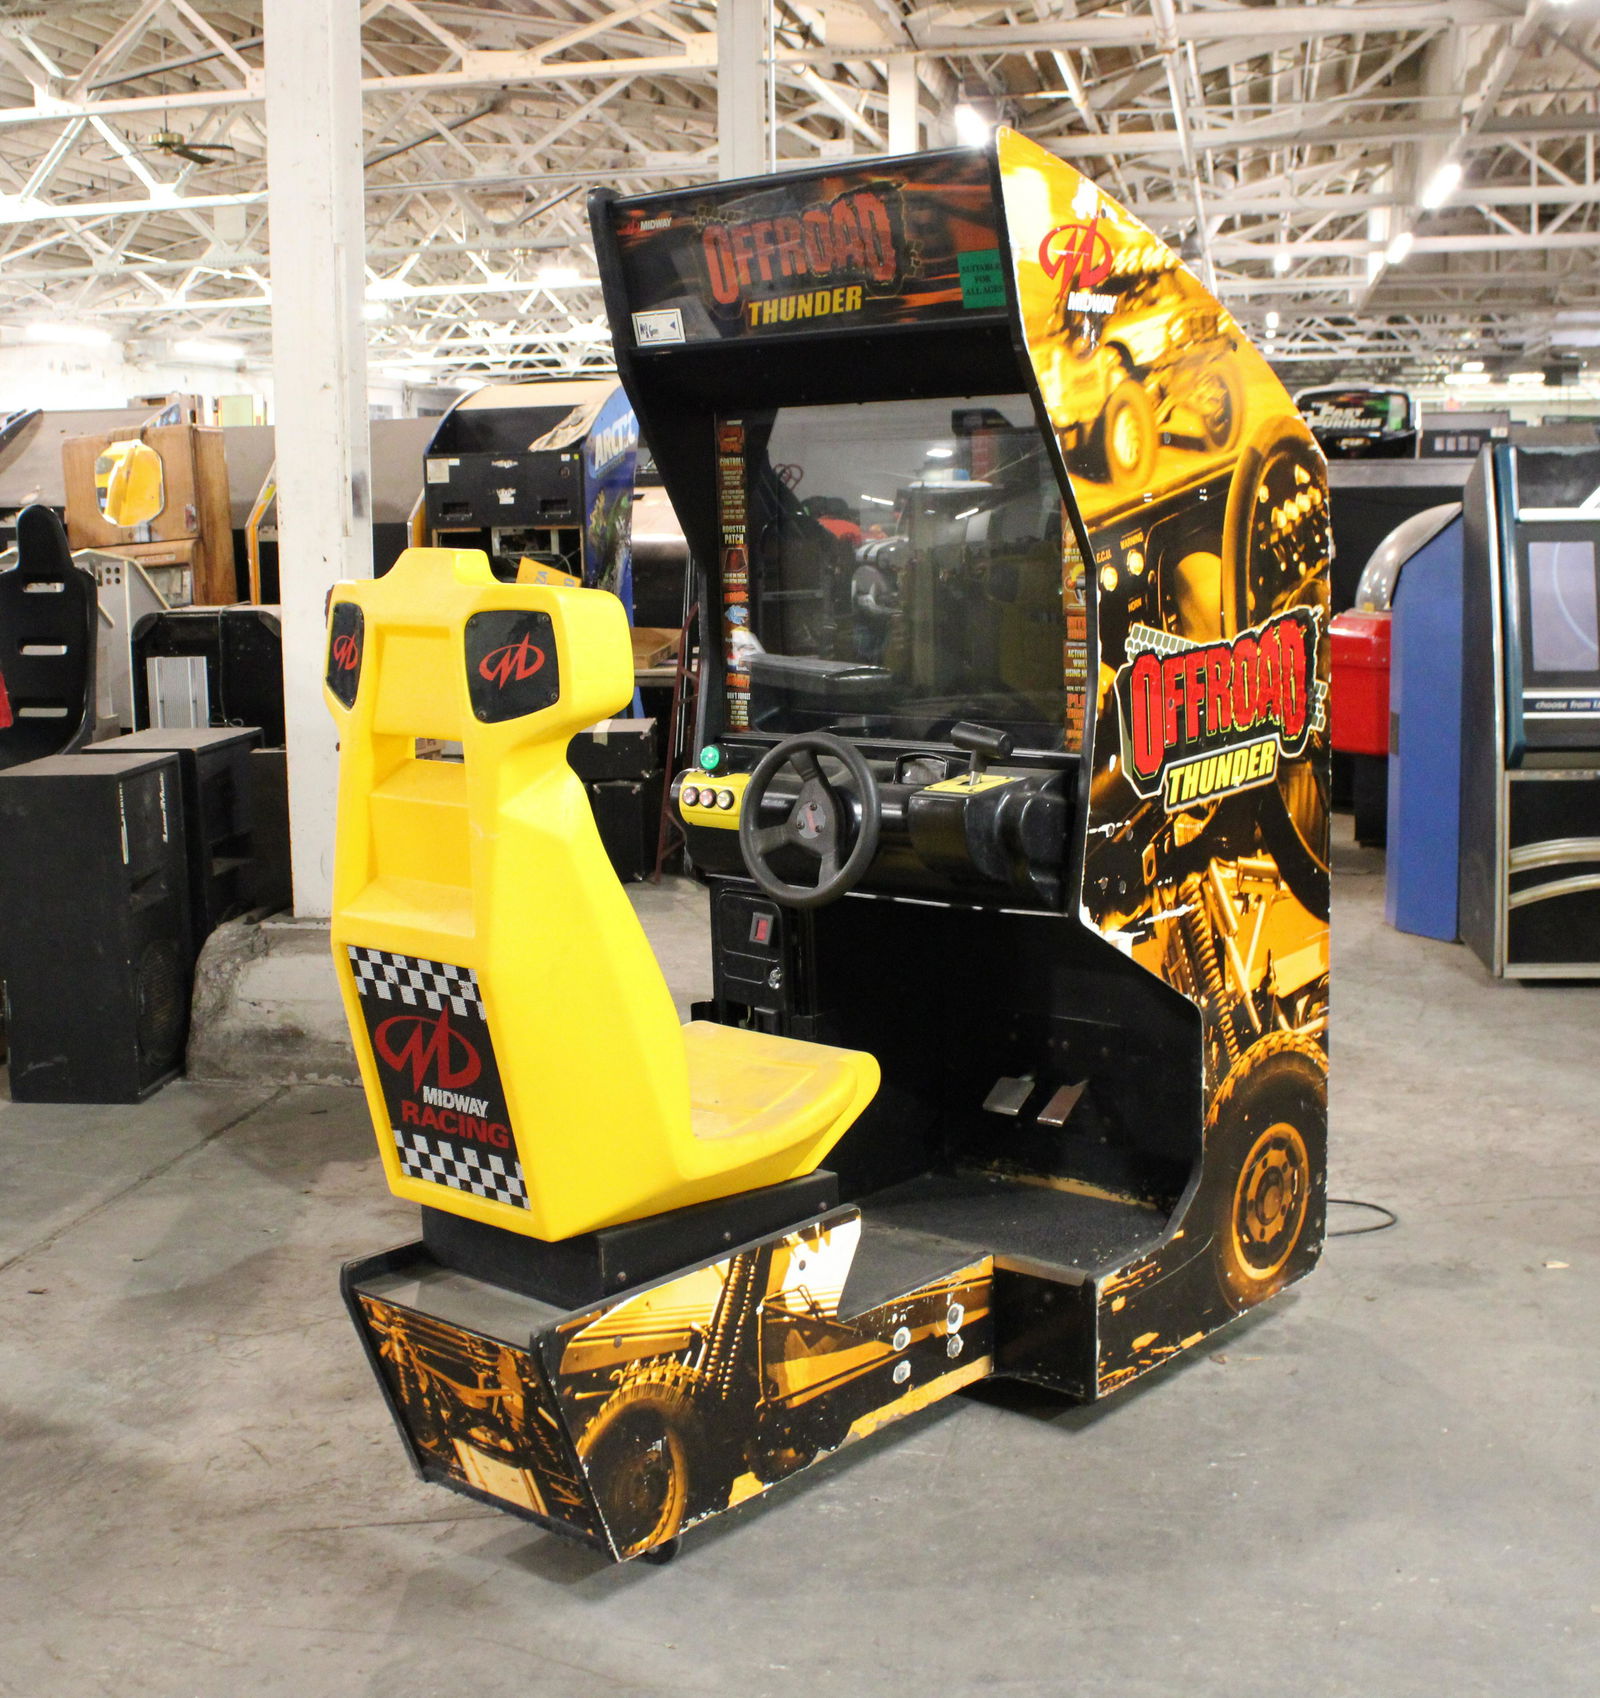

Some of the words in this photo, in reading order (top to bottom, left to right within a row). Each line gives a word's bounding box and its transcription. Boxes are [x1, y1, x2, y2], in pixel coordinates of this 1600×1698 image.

[640, 217, 672, 231] MIDWAY
[702, 193, 898, 305] OFFROAD
[748, 285, 863, 328] THUNDER
[1067, 291, 1118, 314] MIDWAY
[1306, 414, 1383, 429] FURIOUS
[1131, 619, 1307, 776] OFFROAD
[1535, 700, 1568, 710] choose
[1570, 700, 1592, 710] from
[1168, 740, 1277, 805] THUNDER
[423, 1086, 489, 1117] MIDWAY
[402, 1101, 510, 1149] RACING
